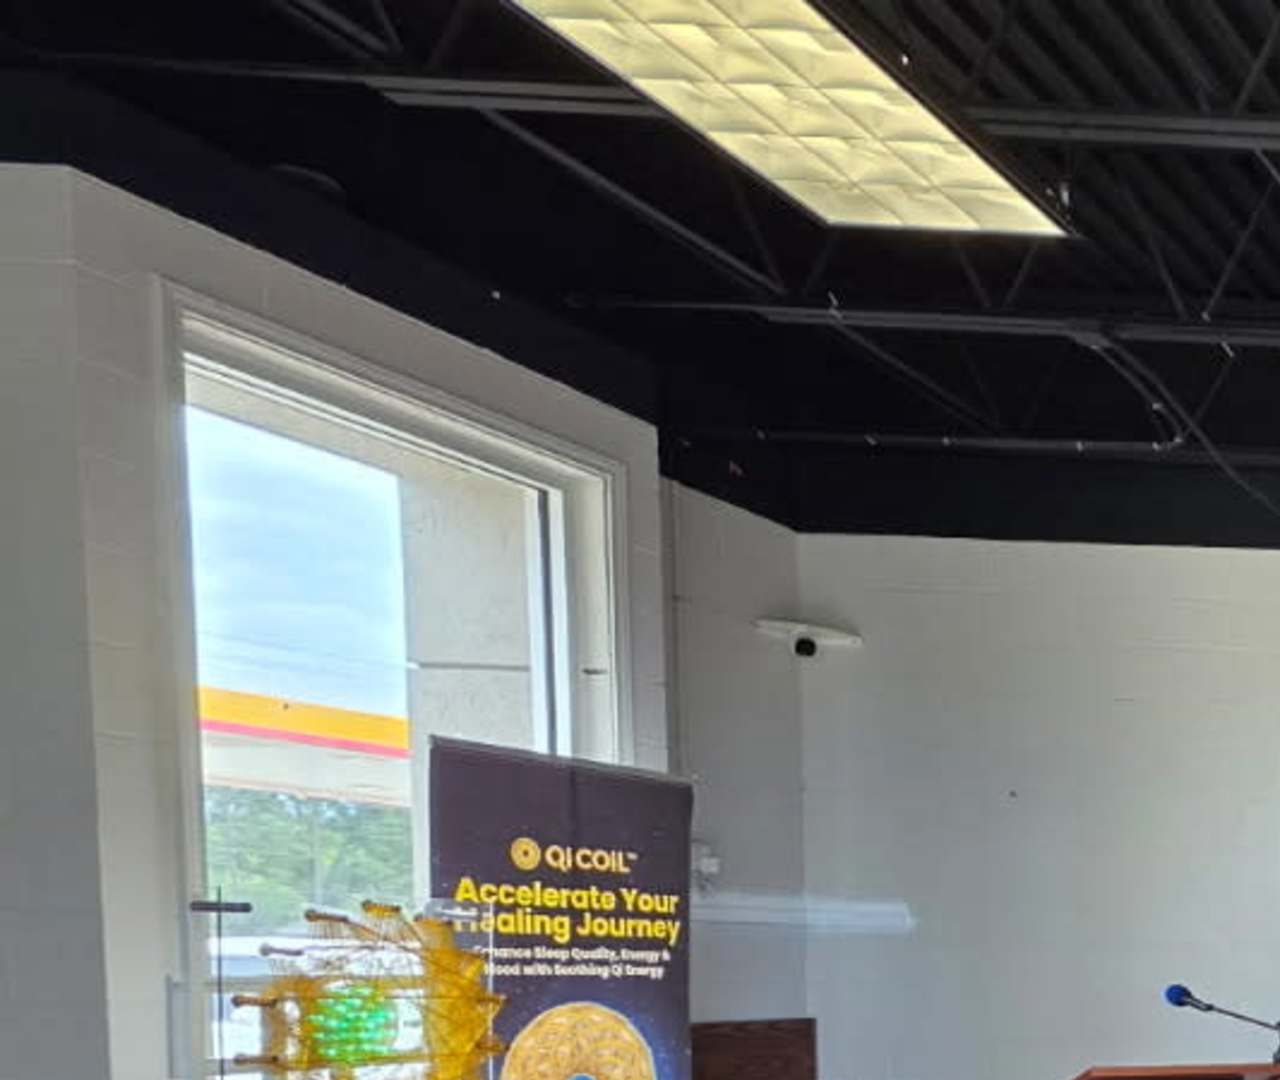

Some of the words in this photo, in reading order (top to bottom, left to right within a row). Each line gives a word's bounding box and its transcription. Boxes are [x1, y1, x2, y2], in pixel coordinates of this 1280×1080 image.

[455, 876, 615, 909] Accelerate
[620, 888, 679, 913] Your
[577, 912, 680, 946] Journey
[534, 946, 569, 962] Sleep
[621, 948, 660, 963] Energy
[523, 962, 553, 976] with
[555, 963, 610, 979] Soothing
[611, 964, 624, 978] Qi
[626, 965, 664, 979] Energy
